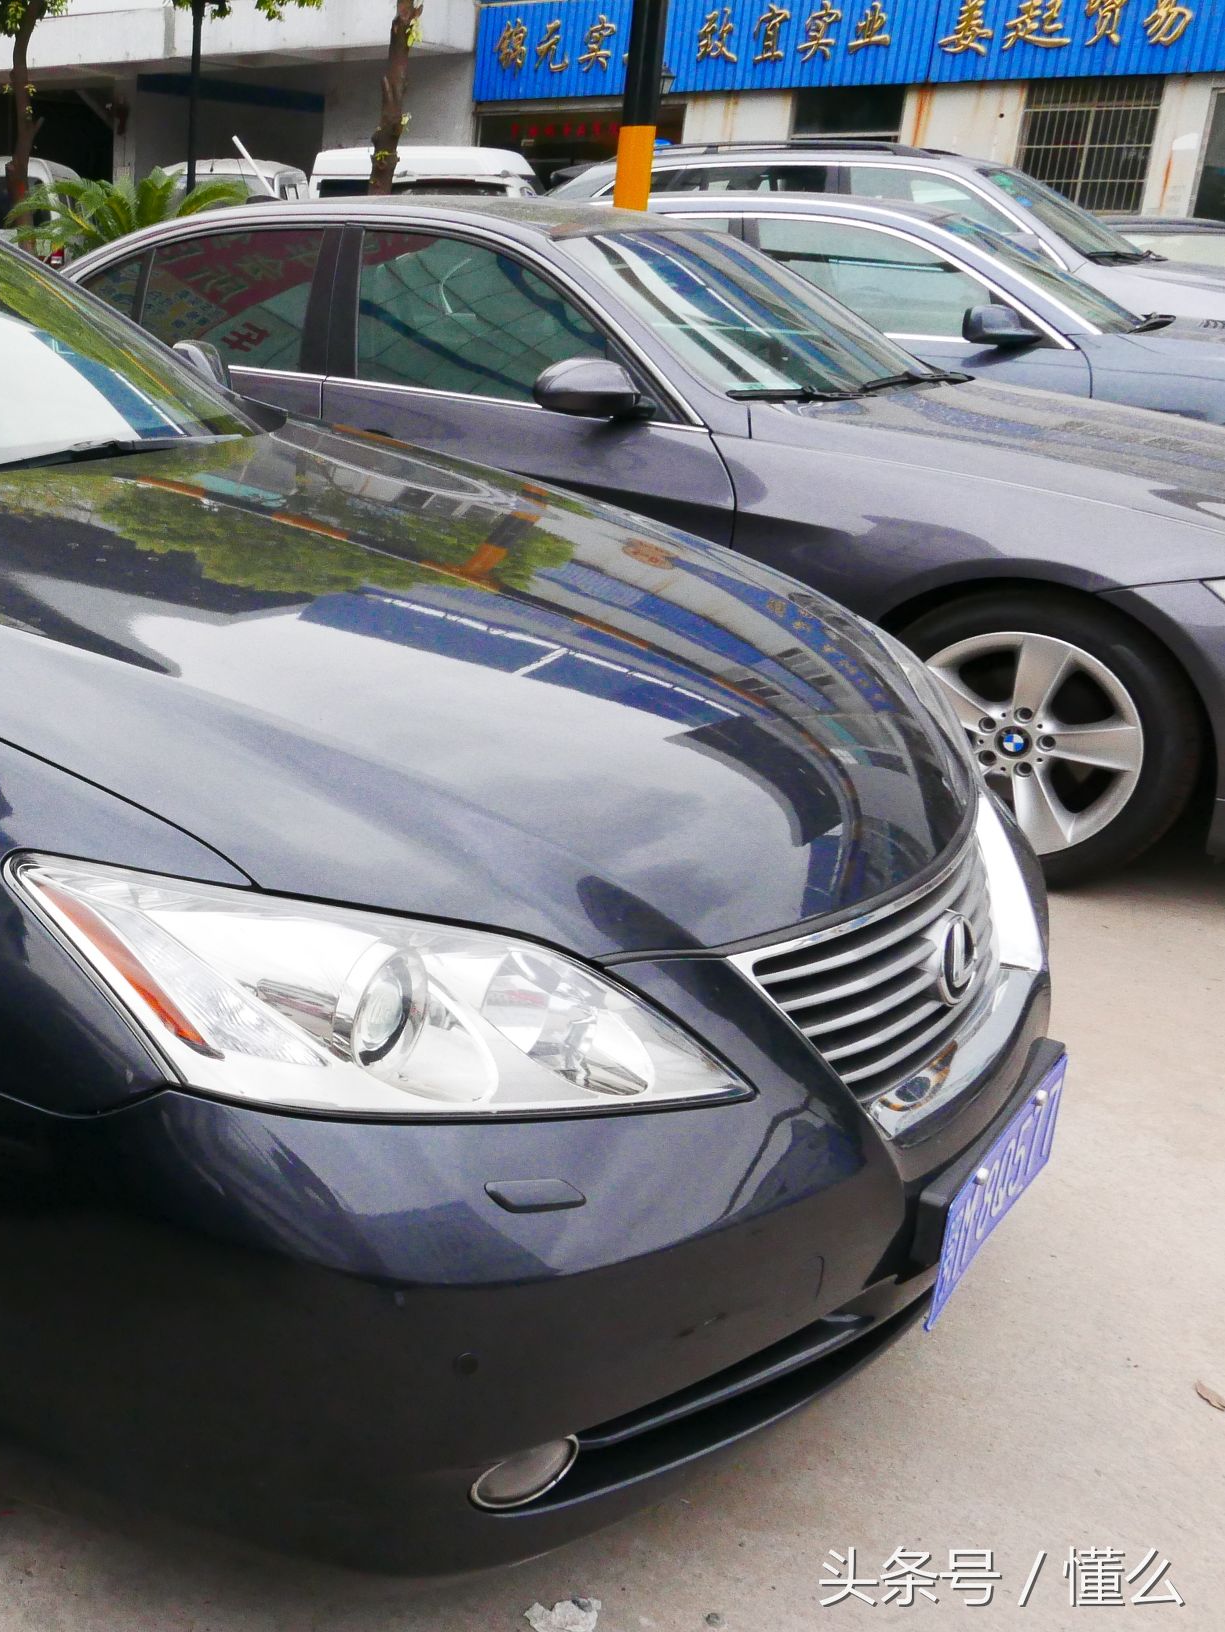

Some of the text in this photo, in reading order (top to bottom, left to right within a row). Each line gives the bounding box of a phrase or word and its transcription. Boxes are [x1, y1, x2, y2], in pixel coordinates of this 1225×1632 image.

[494, 14, 629, 78] 锦元实
[696, 0, 891, 63] 致宜实业
